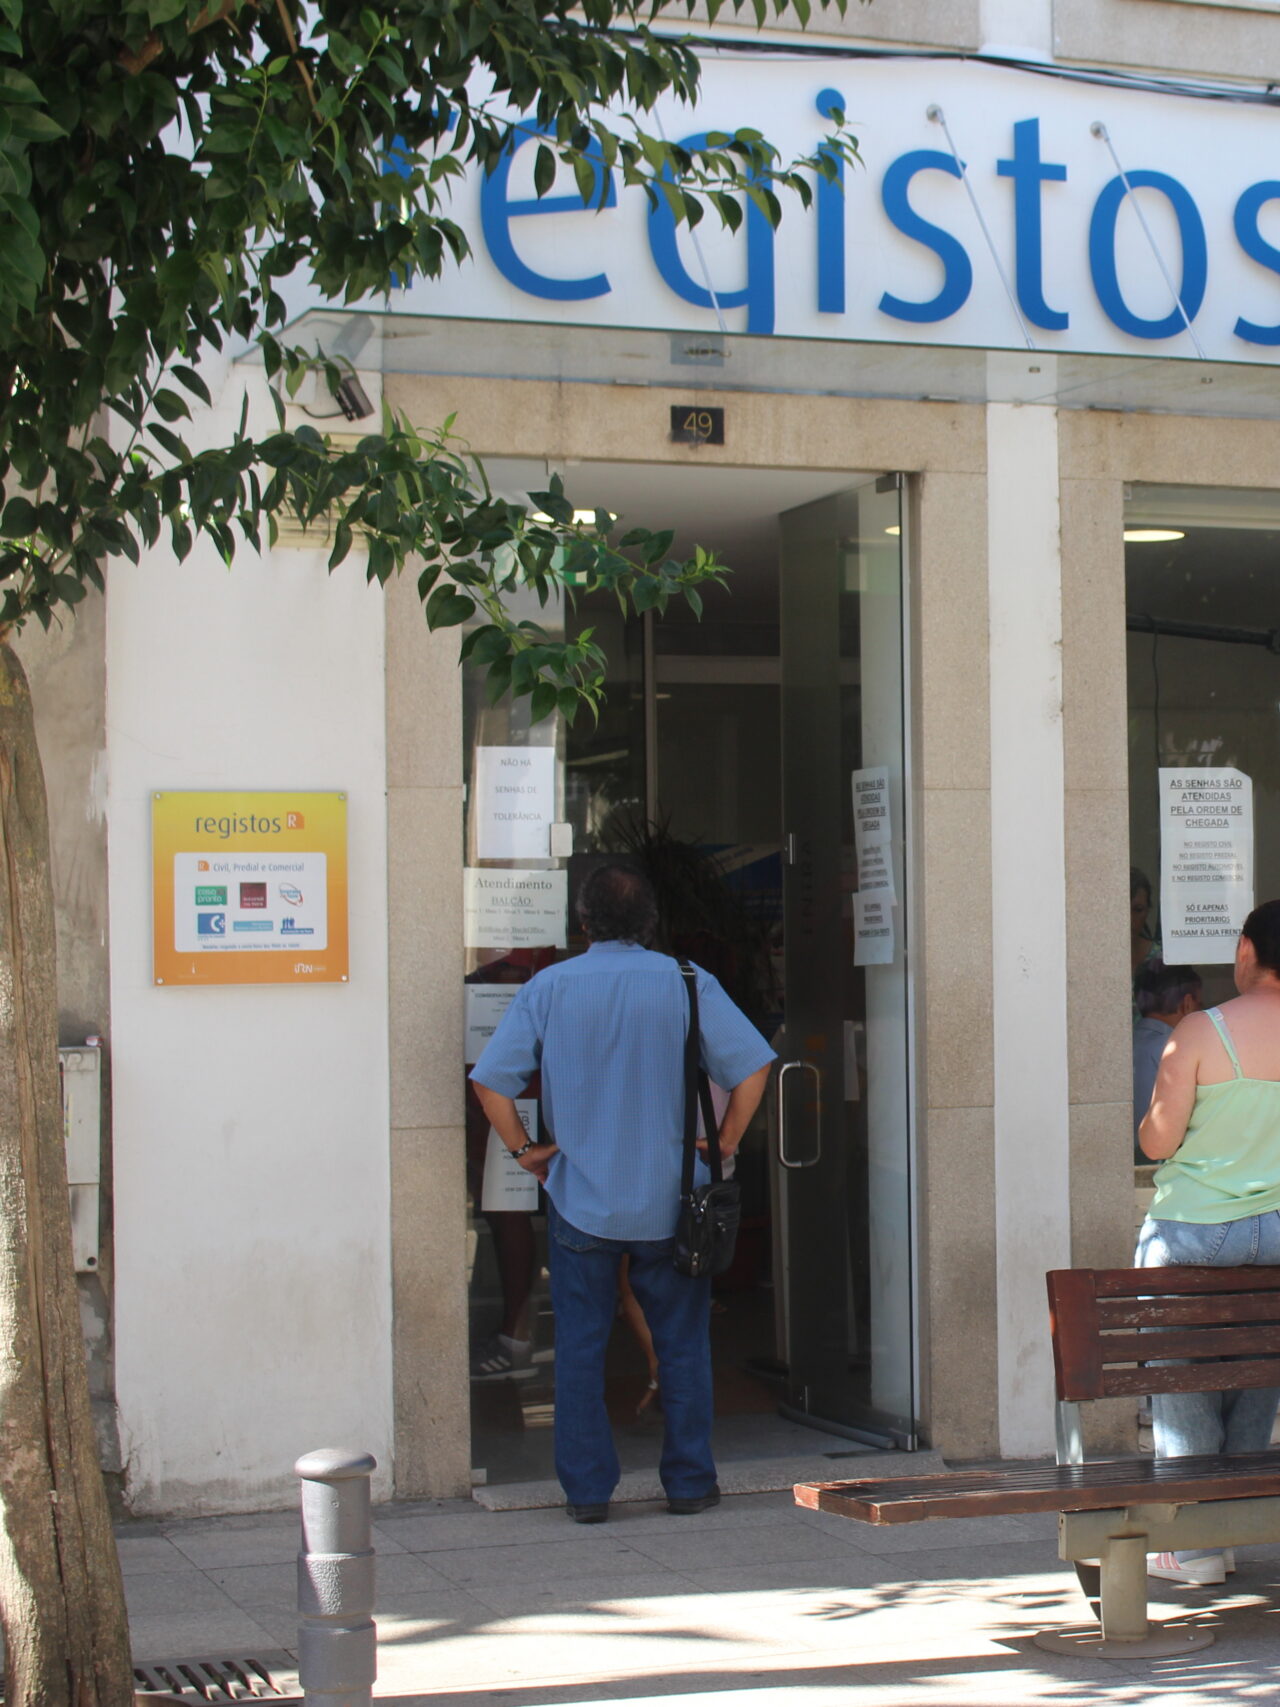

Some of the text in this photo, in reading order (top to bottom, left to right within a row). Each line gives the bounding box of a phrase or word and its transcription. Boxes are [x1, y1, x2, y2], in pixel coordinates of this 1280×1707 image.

[683, 411, 713, 438] 49
[500, 757, 519, 767] NÃO
[1170, 777, 1242, 789] AS SENHAS SÃO
[495, 785, 525, 794] SENHAS
[1181, 792, 1232, 801] ATENDIDAS
[1170, 805, 1243, 815] PELA ORDEM DE
[195, 812, 282, 839] registos
[1185, 818, 1230, 828] CHEGADA
[213, 862, 231, 873] Civil,
[233, 862, 259, 872] Predial
[268, 862, 304, 872] Comercial
[475, 877, 553, 890] Atendimento
[1171, 929, 1198, 937] PASSAM
[1221, 928, 1241, 936] FRENT
